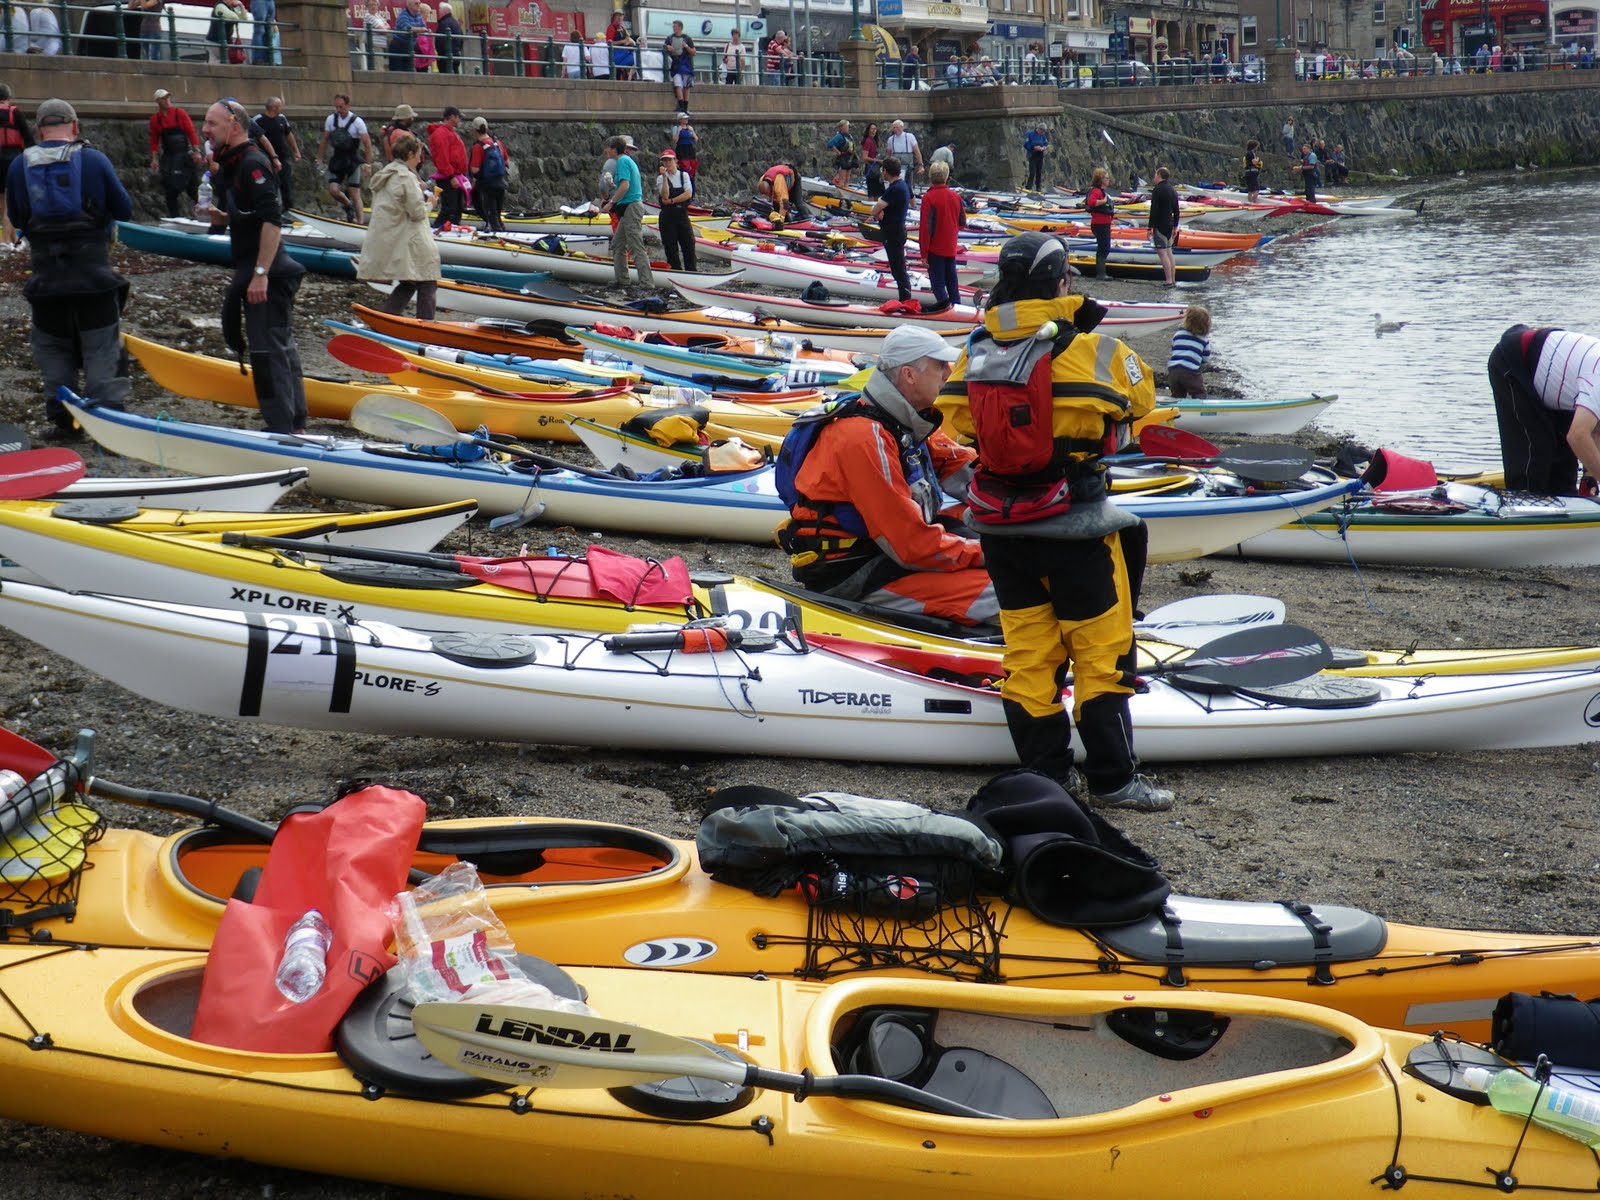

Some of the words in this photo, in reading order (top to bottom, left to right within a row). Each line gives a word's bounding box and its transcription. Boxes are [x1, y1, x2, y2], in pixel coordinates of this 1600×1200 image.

[268, 617, 338, 656] 21
[352, 671, 443, 697] PLORE-S
[797, 688, 892, 708] TIDERACE
[474, 1012, 637, 1055] LENDAL
